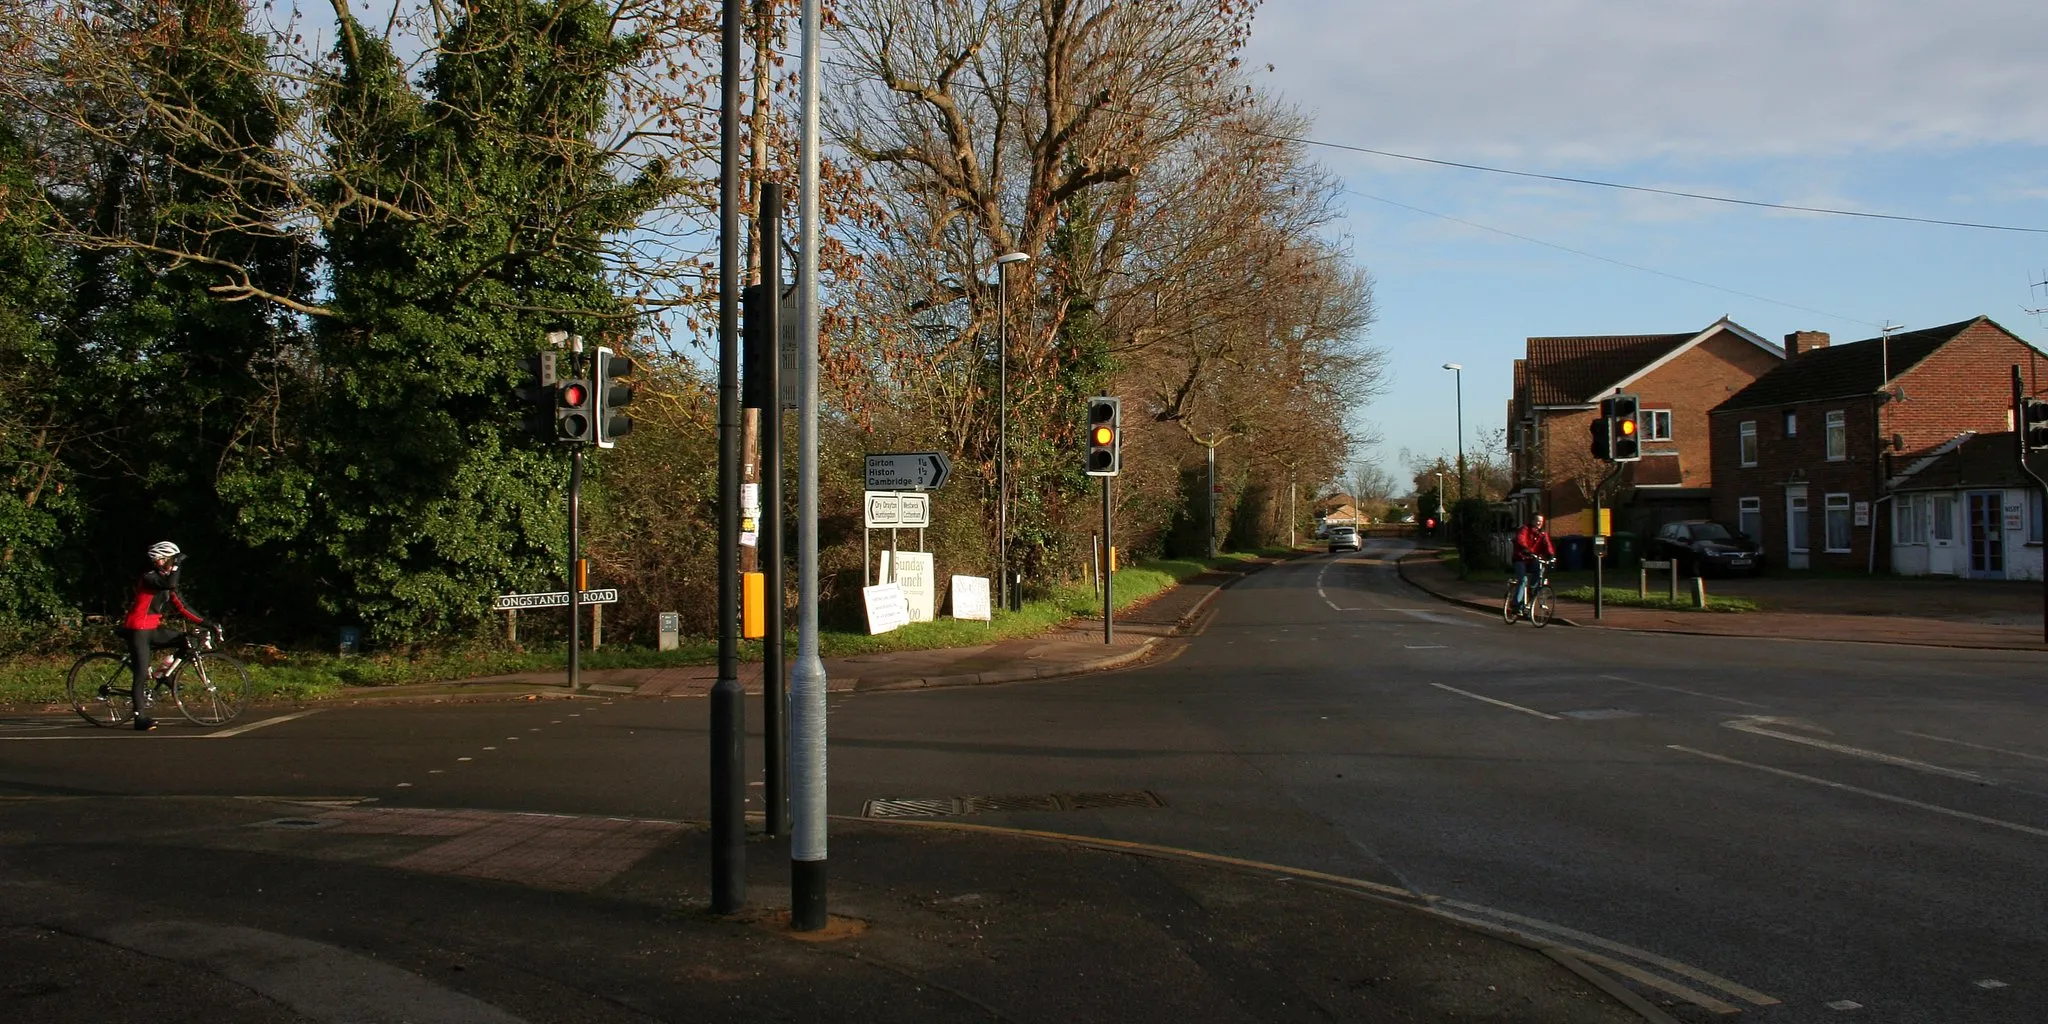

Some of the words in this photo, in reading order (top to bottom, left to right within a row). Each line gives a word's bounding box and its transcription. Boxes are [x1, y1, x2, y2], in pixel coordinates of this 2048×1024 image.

[868, 459, 894, 468] Girton
[868, 468, 895, 476] Histon
[868, 477, 912, 486] Cambridge
[917, 476, 923, 485] 3
[896, 556, 925, 572] Sunday
[897, 573, 922, 587] unch
[583, 592, 613, 602] ROAD
